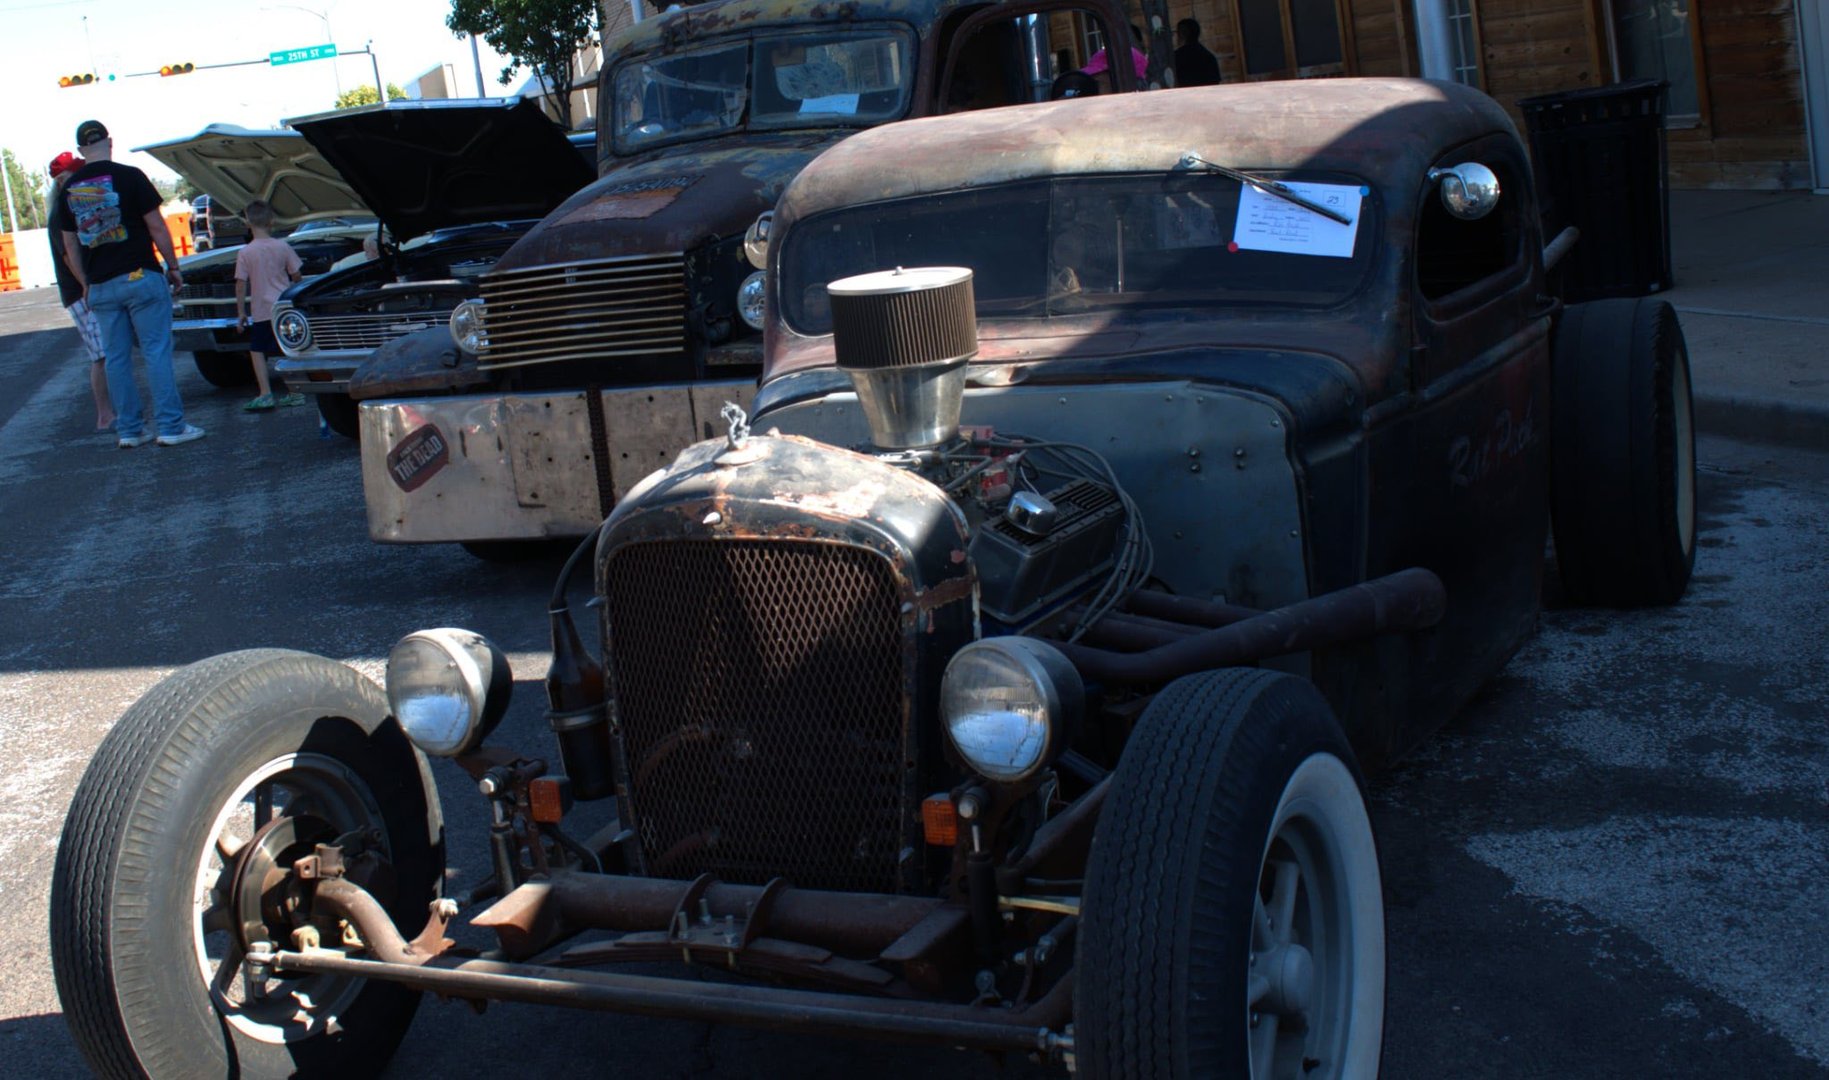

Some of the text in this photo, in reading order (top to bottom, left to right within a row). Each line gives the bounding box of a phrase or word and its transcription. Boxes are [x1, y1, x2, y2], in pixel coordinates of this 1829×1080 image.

[288, 51, 308, 62] 25TH
[310, 48, 319, 58] ST
[394, 456, 418, 481] THE
[412, 435, 443, 467] DEAD
